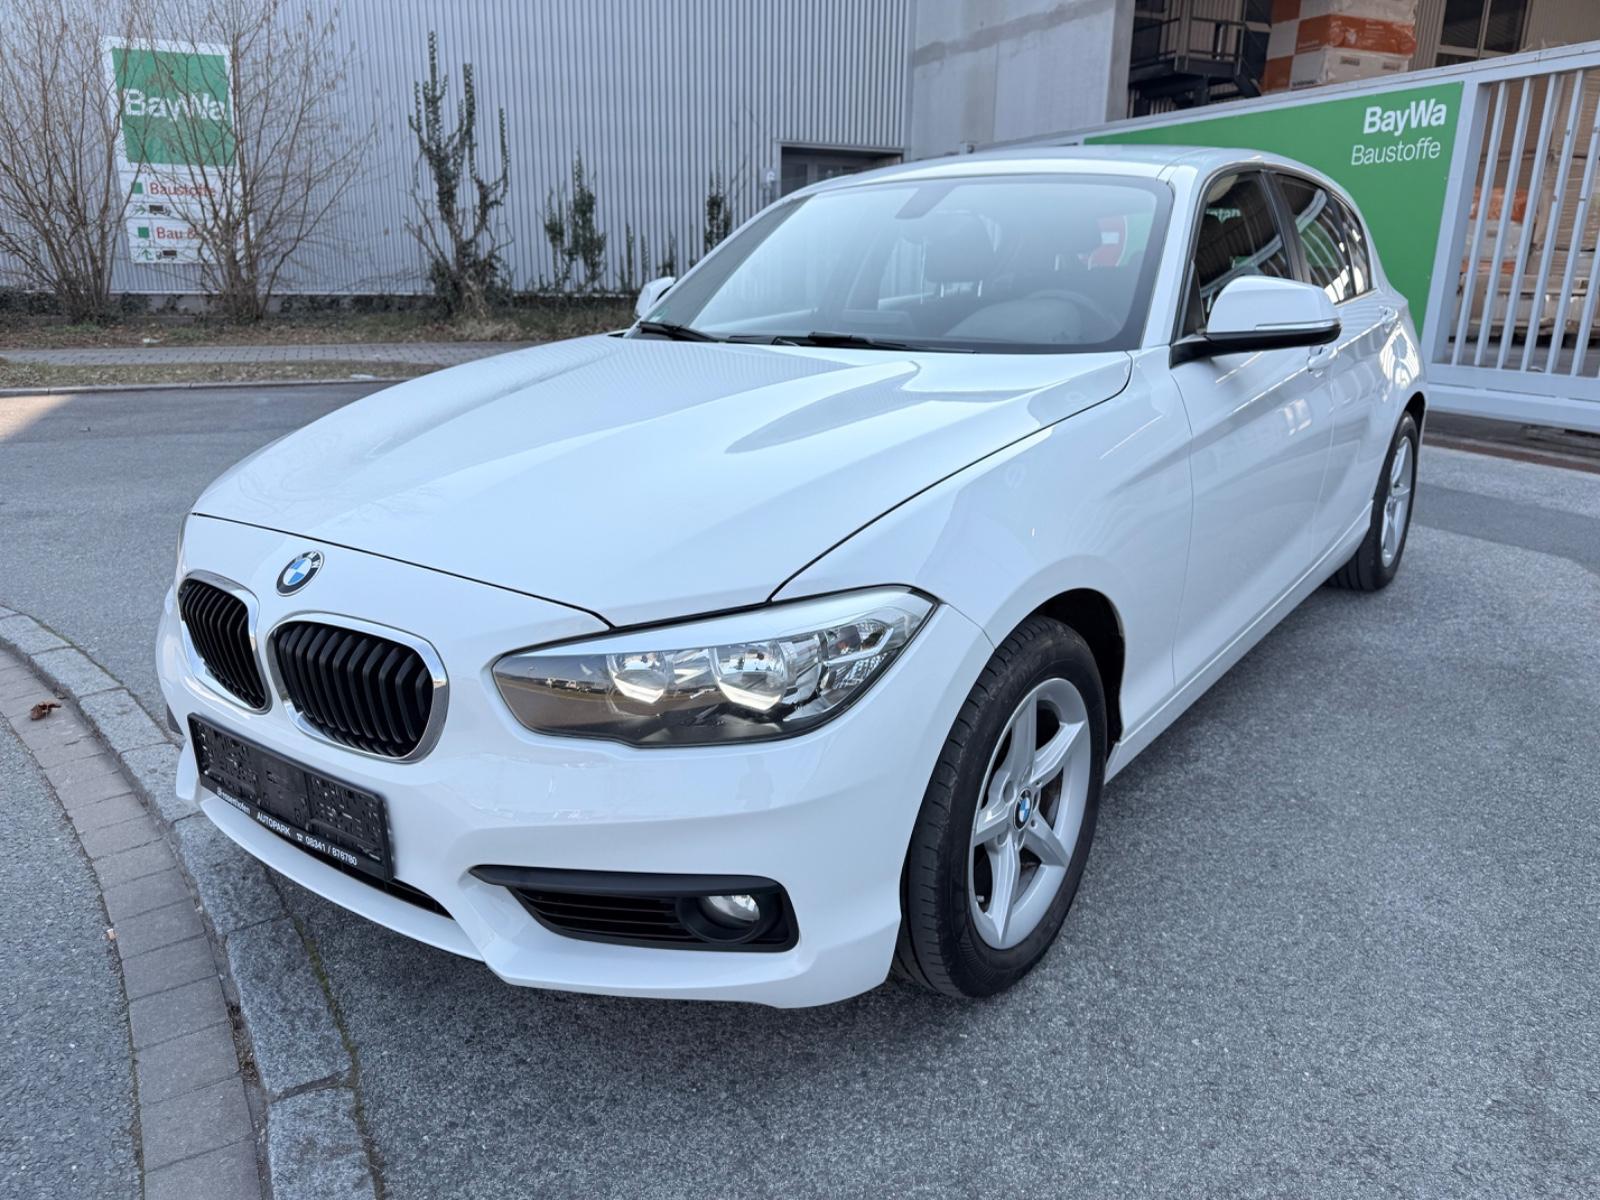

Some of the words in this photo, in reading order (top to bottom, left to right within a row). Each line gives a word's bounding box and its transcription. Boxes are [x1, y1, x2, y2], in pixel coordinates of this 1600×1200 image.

[123, 87, 227, 122] BayWa
[1363, 98, 1447, 136] BayWa
[1351, 136, 1441, 166] Baustoffe
[156, 226, 183, 240] Bau
[256, 811, 291, 836] AUTOPARK
[305, 836, 326, 853] 08341
